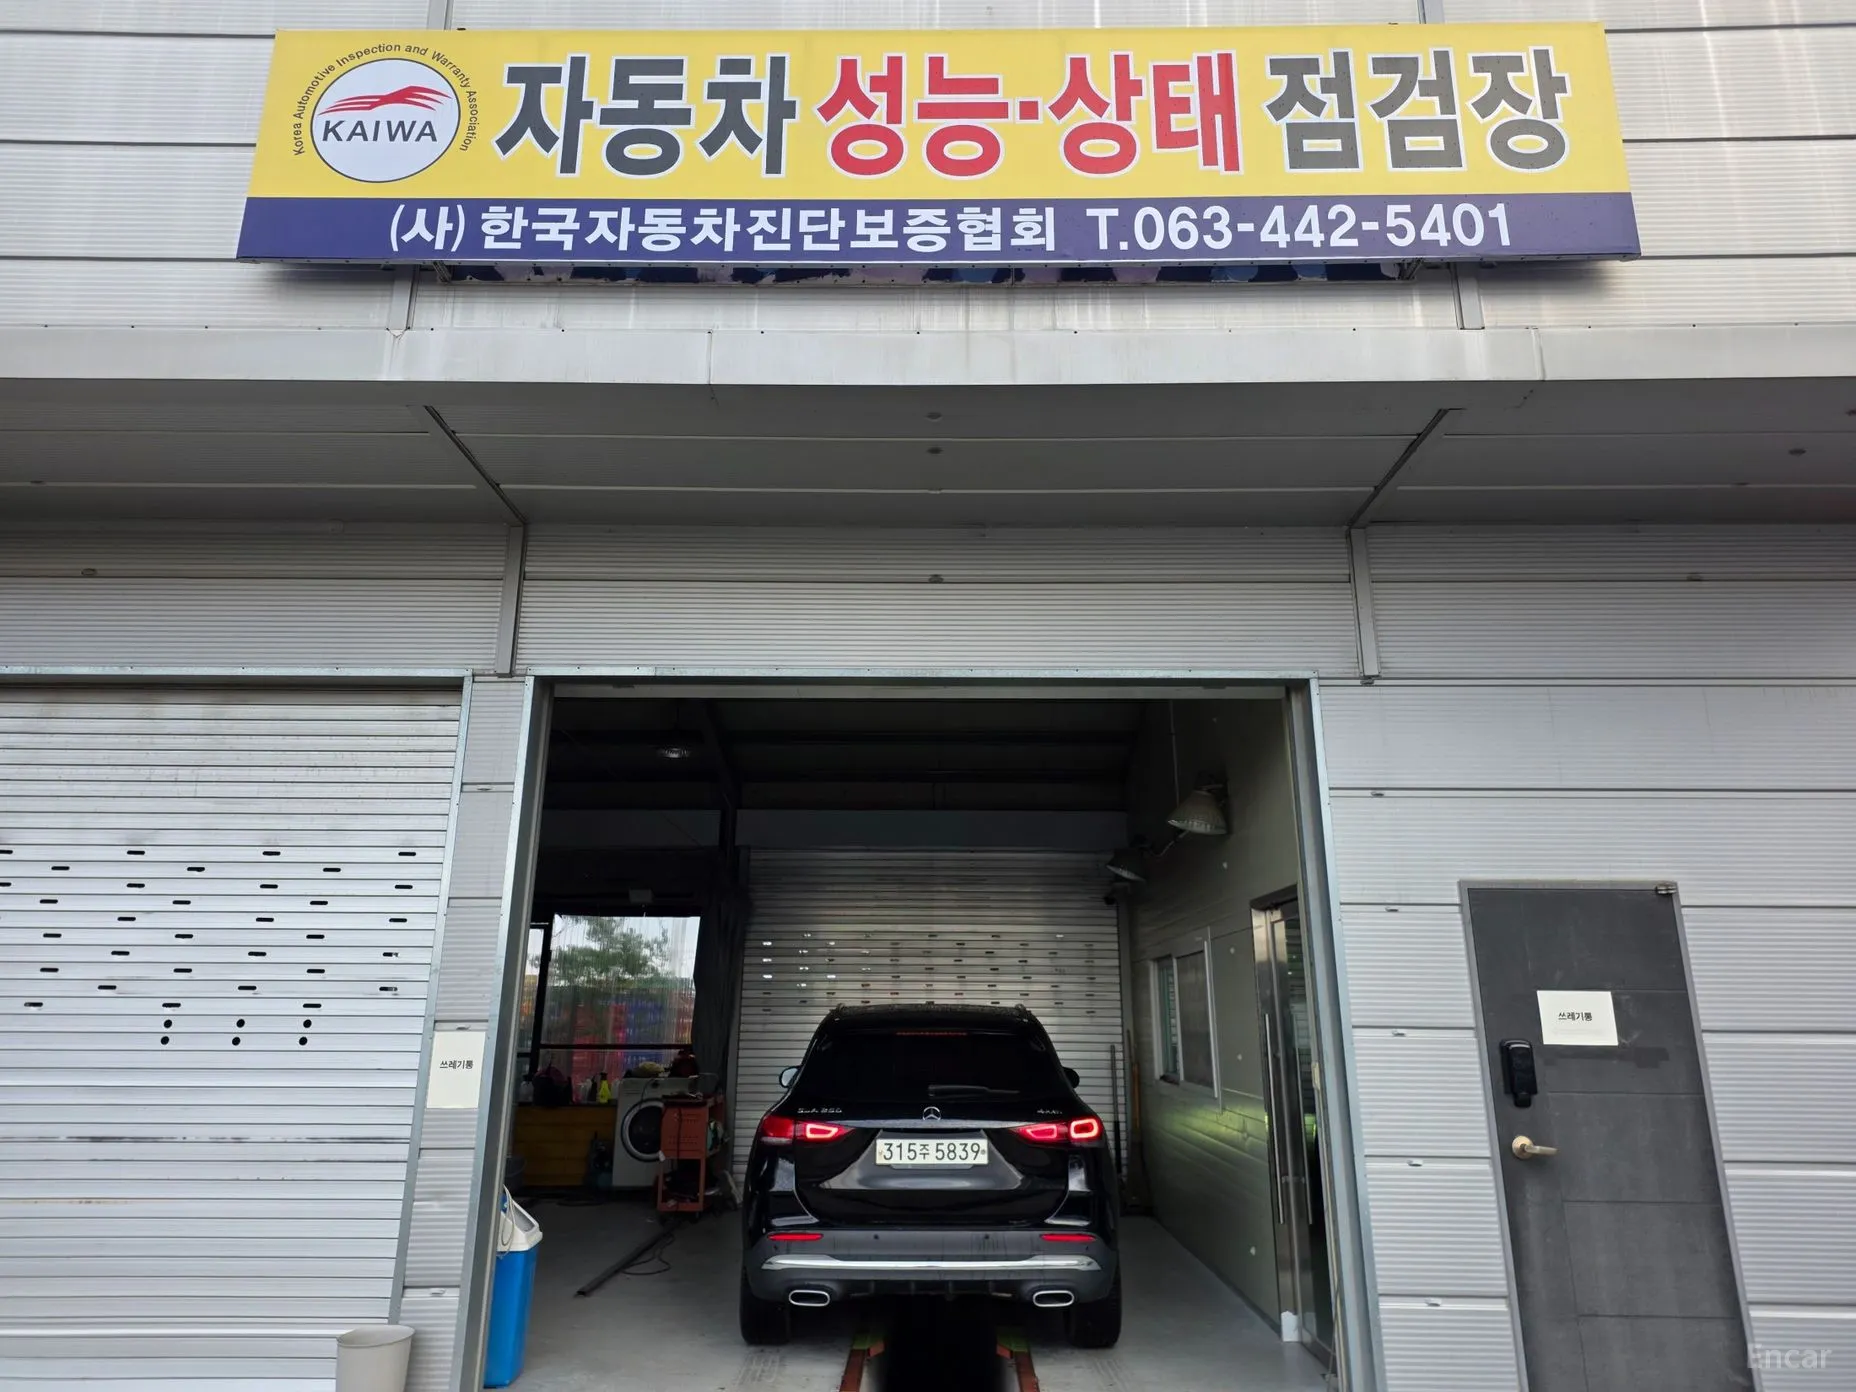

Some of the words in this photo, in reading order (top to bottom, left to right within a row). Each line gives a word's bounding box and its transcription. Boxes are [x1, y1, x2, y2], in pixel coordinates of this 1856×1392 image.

[336, 43, 401, 67] Inspection
[405, 43, 429, 56] and
[431, 50, 471, 88] Warranty
[293, 64, 336, 120] Automotive
[459, 90, 480, 152] Association
[494, 55, 798, 176] 자동차
[1264, 48, 1569, 172] 점검장
[293, 123, 305, 156] Korea
[322, 120, 438, 142] KAIWA
[390, 204, 466, 253] (사)
[481, 205, 1055, 253] 한국자동차진단보증협회
[1558, 1011, 1593, 1022] 쓰레기통
[440, 1060, 474, 1069] 쓰레기통
